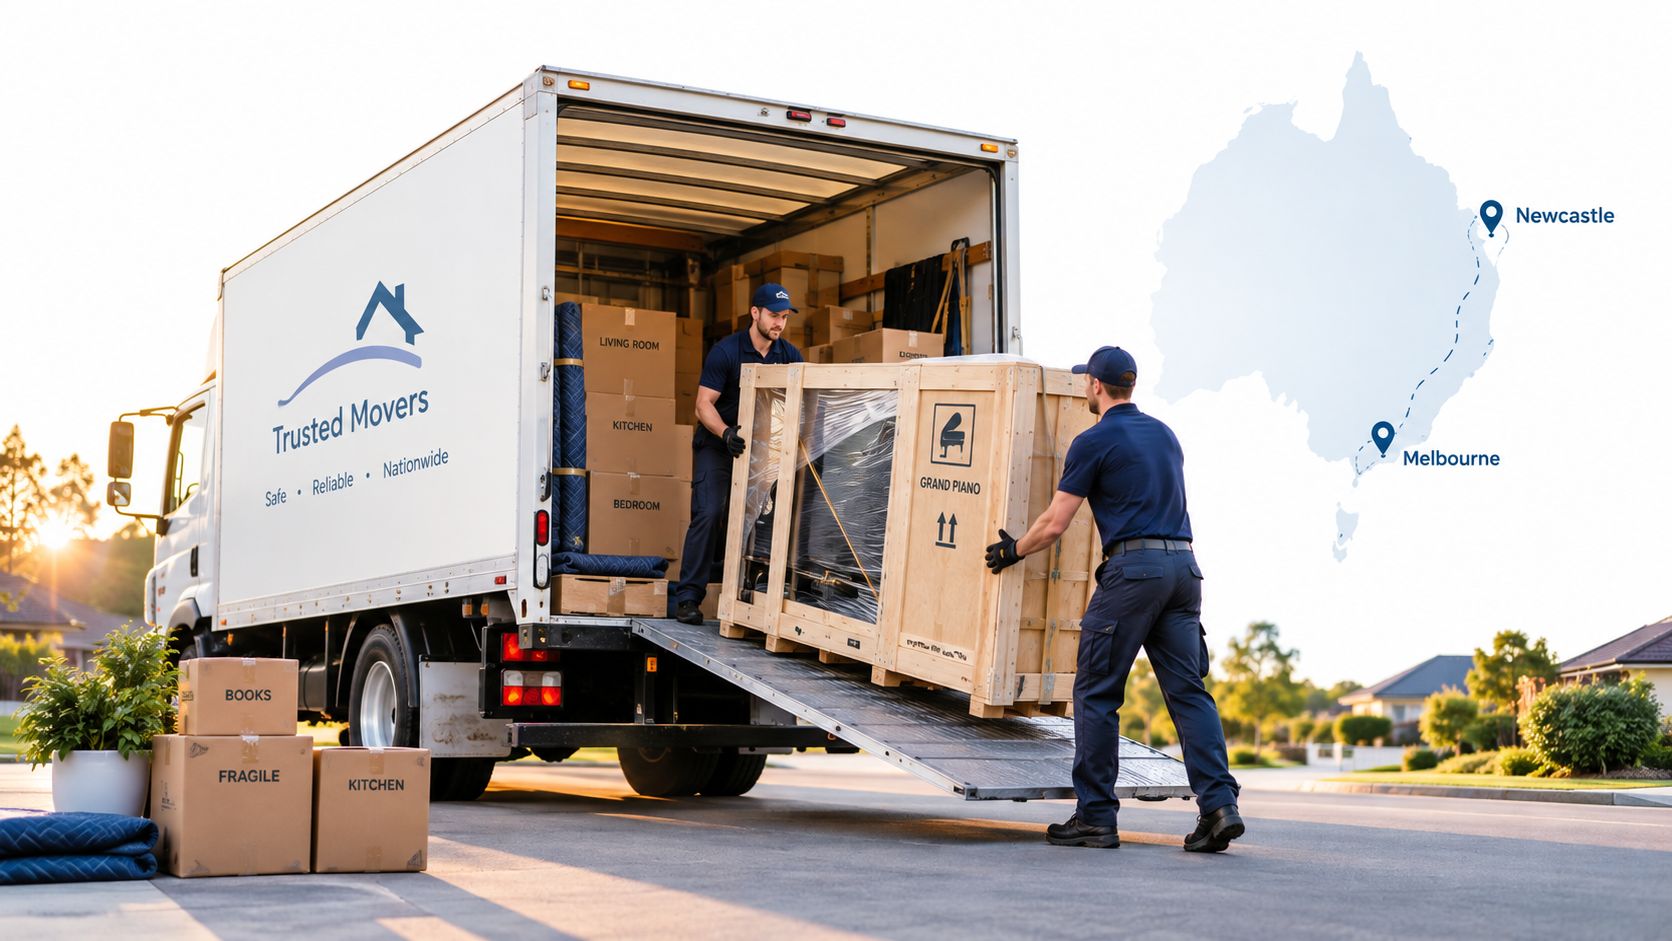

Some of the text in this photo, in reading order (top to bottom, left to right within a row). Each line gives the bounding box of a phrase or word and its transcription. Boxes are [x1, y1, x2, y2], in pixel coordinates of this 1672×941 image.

[599, 337, 660, 351] LIVING ROOM
[272, 390, 429, 454] Trusted Movers
[612, 420, 653, 433] KITCHEN
[265, 447, 449, 508] Safe Reliable Nationwide
[920, 477, 981, 494] GRAND PIANO
[613, 499, 661, 512] BEDROOM
[225, 689, 272, 702] BOOKS
[218, 769, 280, 784] FRAGILE
[348, 778, 405, 791] KITCHEN
